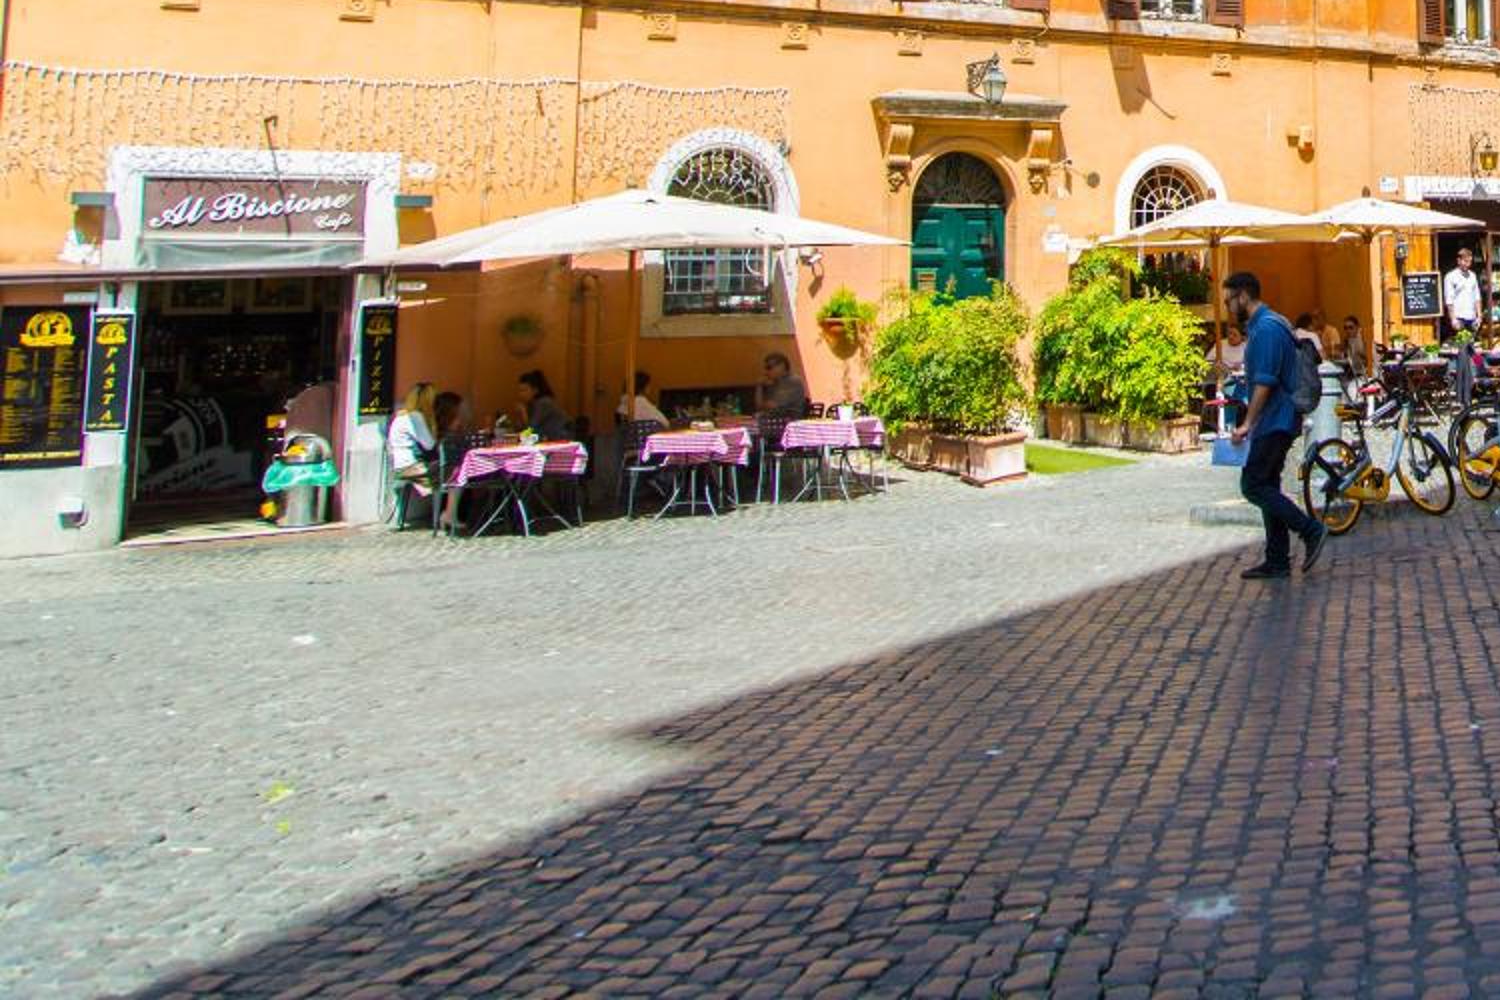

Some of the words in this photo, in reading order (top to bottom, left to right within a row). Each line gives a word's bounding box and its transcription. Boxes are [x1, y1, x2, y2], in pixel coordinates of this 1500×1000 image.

[150, 195, 206, 228] Al
[208, 191, 356, 221] Biscione
[101, 347, 118, 422] PASTA
